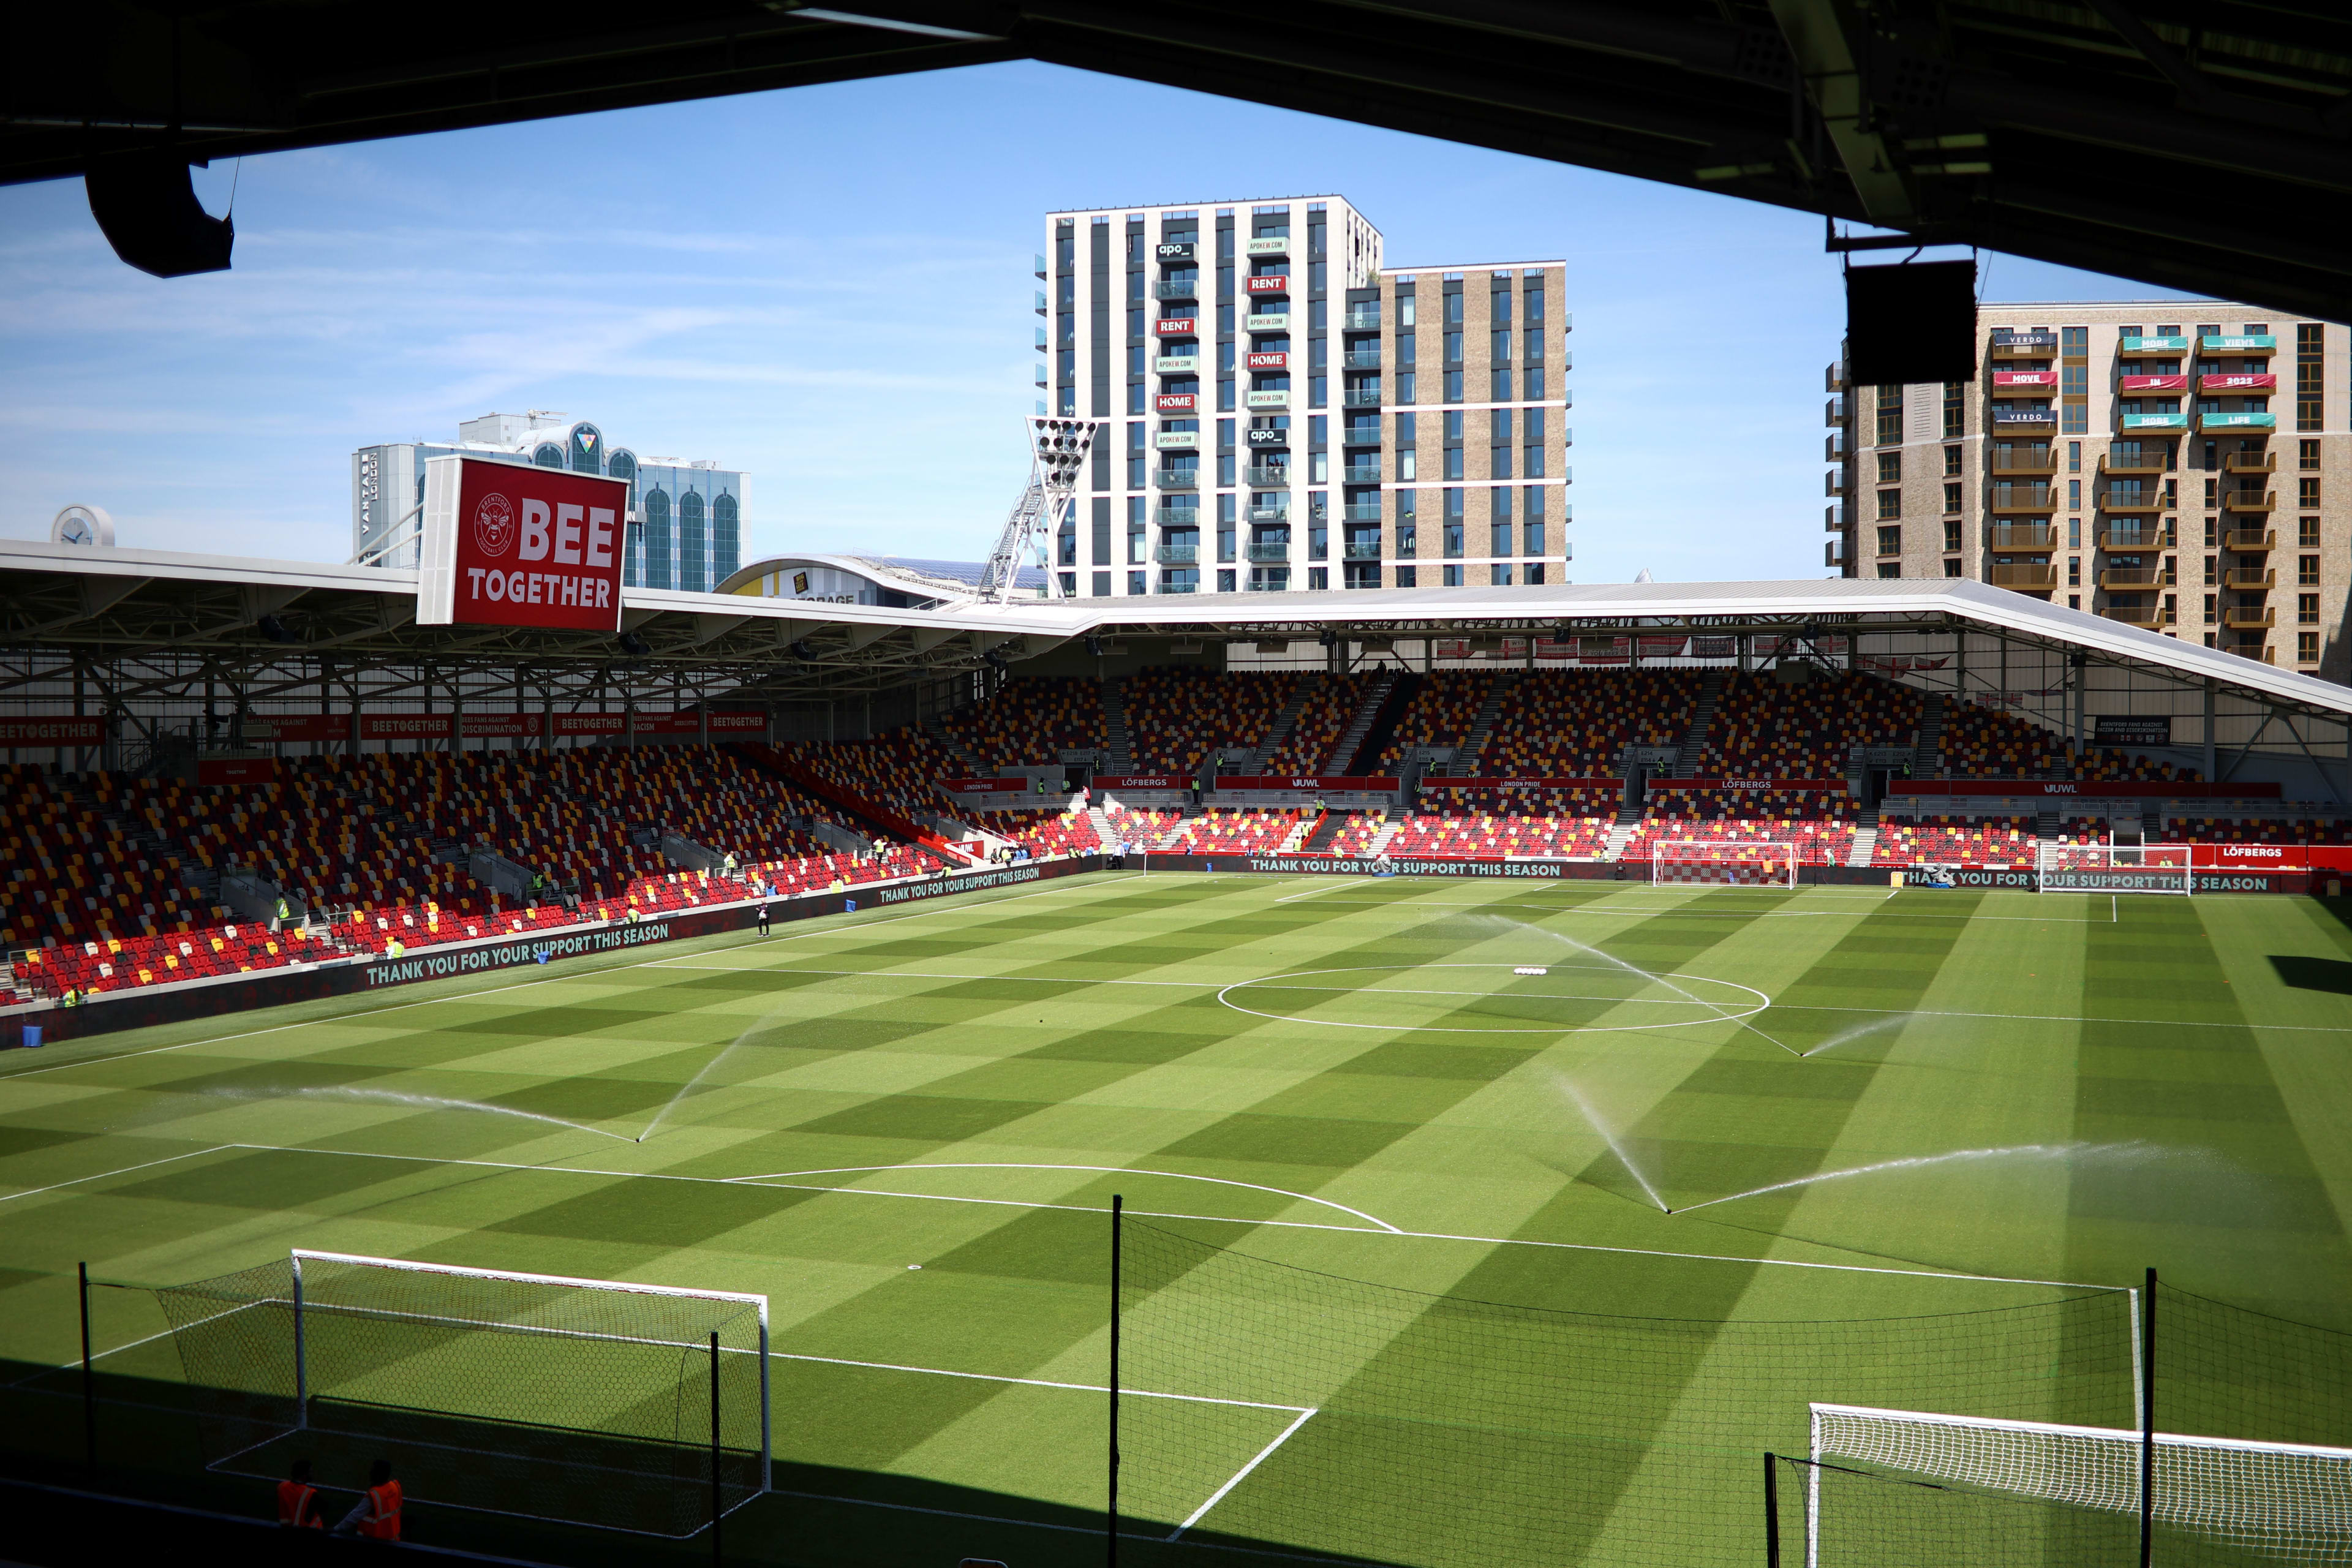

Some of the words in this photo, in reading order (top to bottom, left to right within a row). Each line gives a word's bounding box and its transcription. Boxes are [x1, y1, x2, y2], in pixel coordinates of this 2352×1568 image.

[1250, 241, 1283, 249] APOKEW.COM
[1251, 278, 1281, 288] RENT
[1161, 321, 1189, 331] RENT
[1251, 355, 1283, 366] HOME
[1159, 396, 1191, 407] HOME
[481, 496, 510, 513] BRENTFORD
[518, 497, 615, 568] BEE
[467, 567, 610, 608] TOGETHER
[372, 719, 448, 733] BEETOGETHER
[562, 717, 622, 729] BEETOGETHER
[713, 717, 763, 727] BEETOGETHER
[0, 723, 97, 739] EETOGETHER
[462, 725, 522, 733] DISCRIMINATION
[1121, 777, 1167, 786] LÖFBERGS
[1722, 779, 1771, 788] LÖFBERGS
[2223, 846, 2282, 857] LÖFBERGS
[1251, 860, 1299, 870] THANK
[1302, 861, 1330, 872] YOU
[1332, 861, 1359, 872] FOR
[1362, 861, 1400, 873] YOR
[1403, 862, 1466, 874] SUPPORT
[1469, 864, 1501, 875] THIS
[1504, 864, 1561, 876] SEASON
[880, 886, 909, 903] THANK
[910, 884, 926, 898] YOU
[928, 882, 943, 895] FOR
[944, 878, 964, 892] YOUR
[965, 873, 997, 889] SUPPORT
[998, 871, 1014, 884] THIS
[1014, 867, 1039, 882] SEASON
[1902, 872, 1955, 884] THA
[1959, 873, 1993, 885] YOU
[1997, 873, 2028, 886] FOR
[2032, 874, 2076, 886] YOUR
[2080, 875, 2156, 888] SUPPORT
[2158, 876, 2197, 889] THIS
[2201, 878, 2268, 891] SEASON
[366, 960, 423, 986] THANK
[426, 956, 457, 975] YOU
[460, 950, 489, 970] FOR
[492, 944, 529, 965] YOUR
[532, 934, 591, 959] SUPPORT
[594, 930, 621, 949] THIS
[623, 923, 668, 944] SEASON
